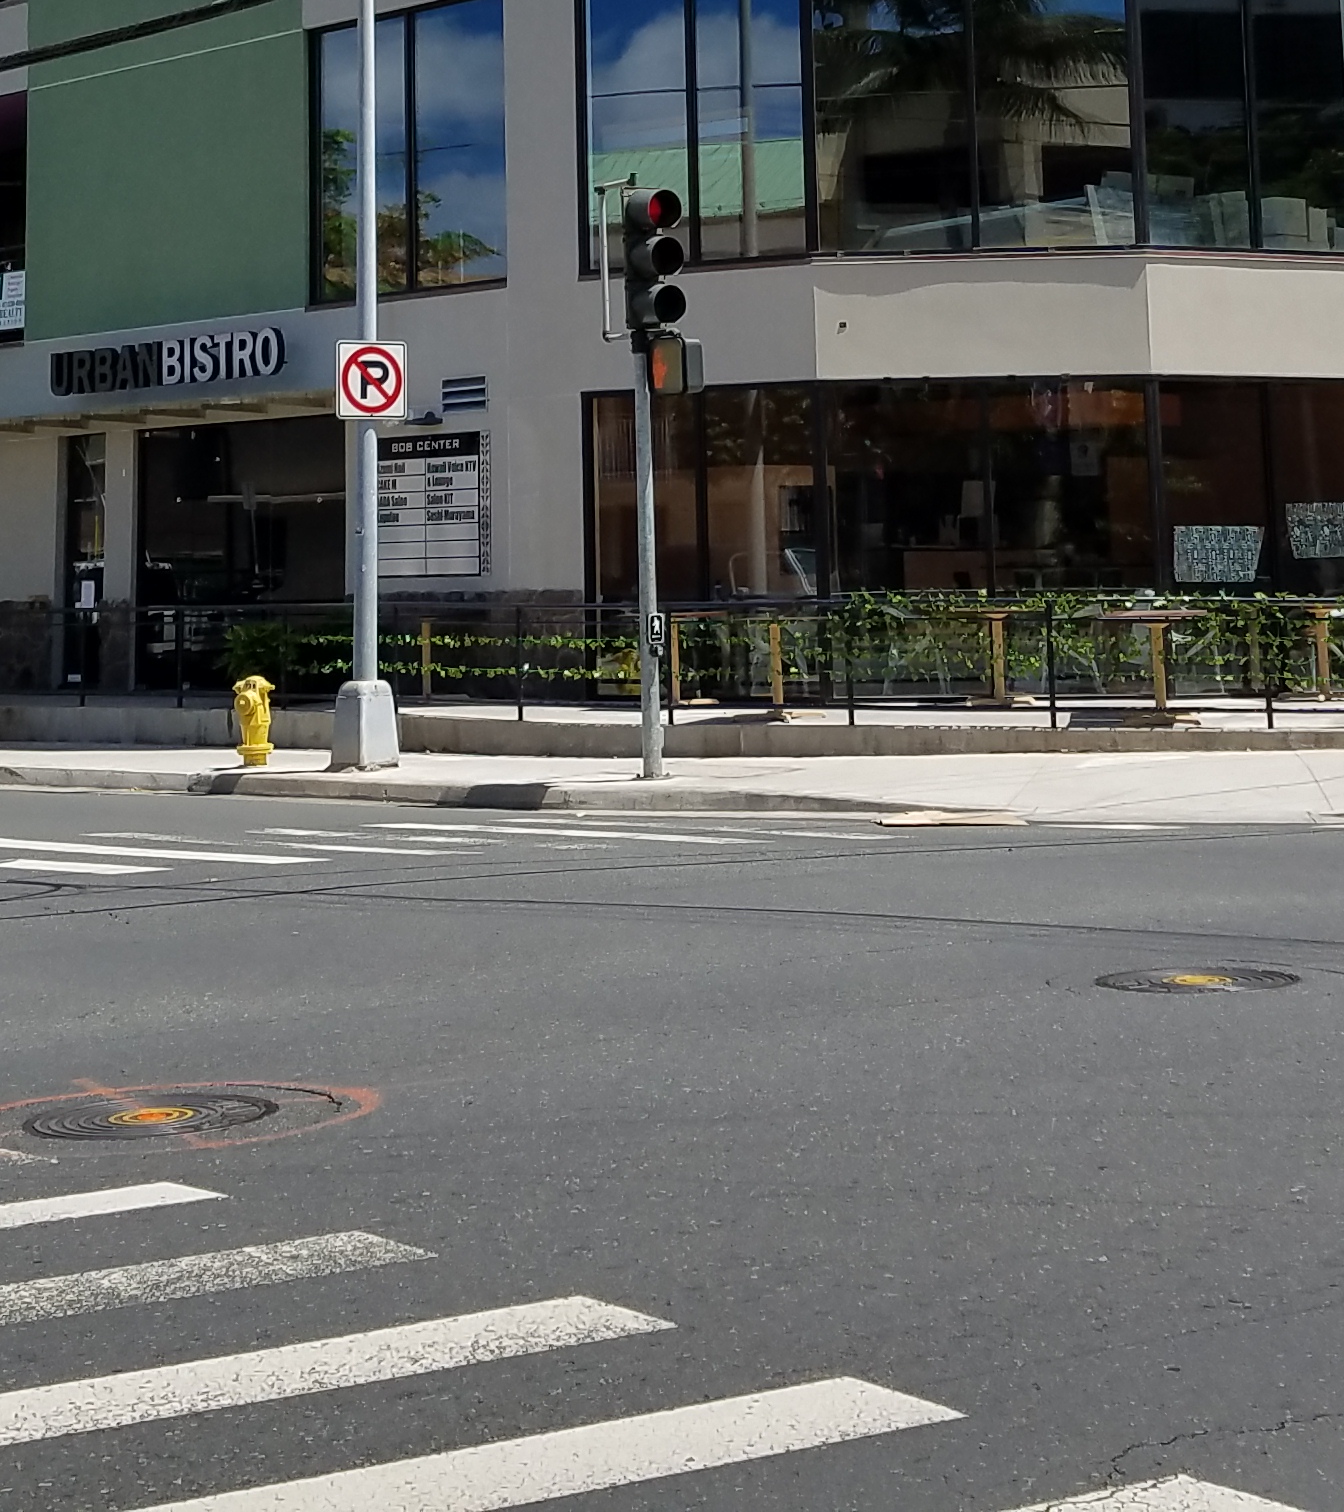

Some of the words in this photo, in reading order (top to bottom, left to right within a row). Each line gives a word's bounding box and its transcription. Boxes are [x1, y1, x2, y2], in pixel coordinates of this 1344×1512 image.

[416, 438, 460, 451] CENTER
[464, 460, 476, 473] KTV
[427, 493, 443, 506] Salon
[427, 509, 443, 522] Sushi
